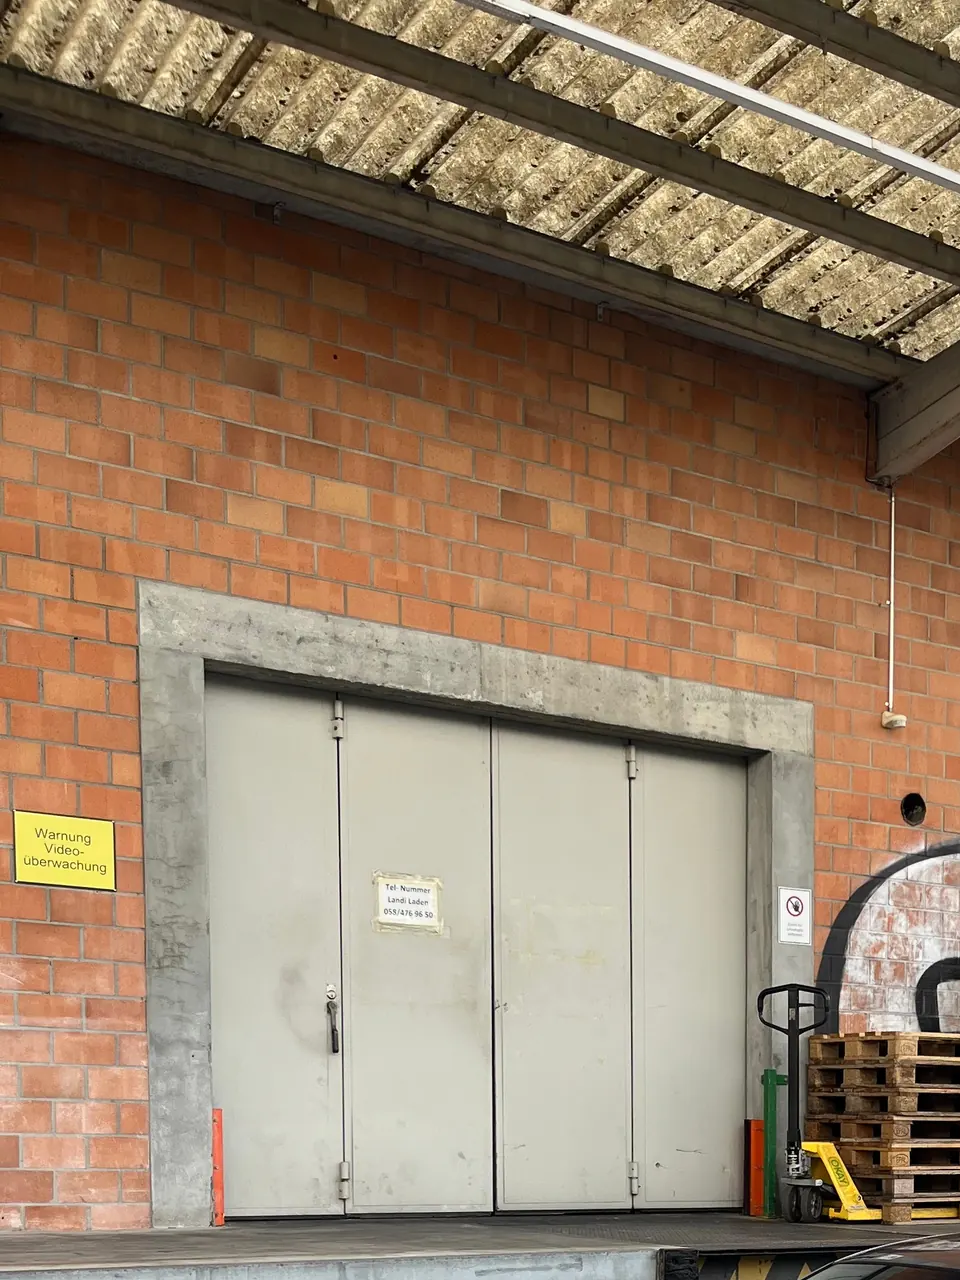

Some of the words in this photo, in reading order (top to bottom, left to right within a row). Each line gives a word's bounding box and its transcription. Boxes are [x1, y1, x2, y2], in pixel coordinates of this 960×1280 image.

[35, 828, 91, 846] Warnung
[44, 843, 85, 856] Video-
[23, 855, 107, 875] überwachung
[400, 885, 431, 894] Nummer
[387, 896, 407, 904] Landi
[408, 898, 429, 906] Laden
[414, 910, 424, 918] 96
[424, 911, 434, 919] 50
[831, 1159, 848, 1184] OKAY
